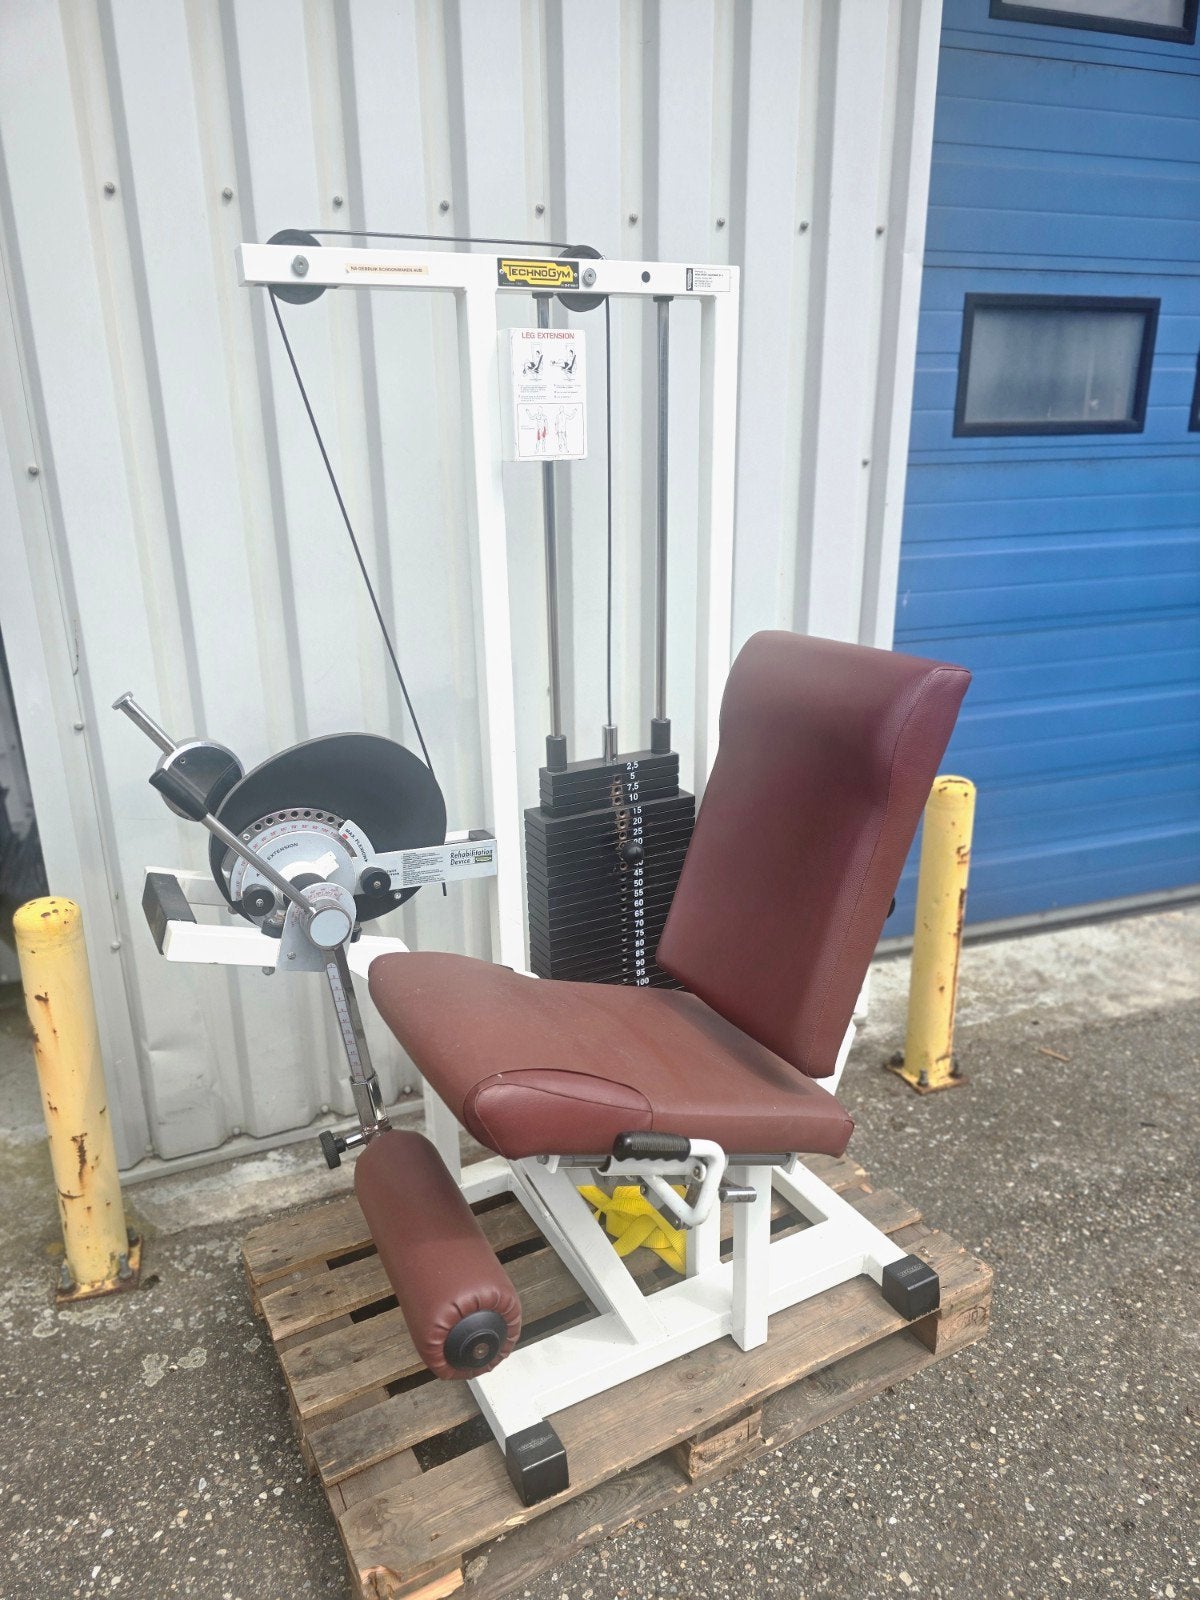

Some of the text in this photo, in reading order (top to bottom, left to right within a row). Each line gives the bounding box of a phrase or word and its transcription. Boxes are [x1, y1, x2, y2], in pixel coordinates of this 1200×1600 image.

[521, 332, 576, 340] LEG EXTENSION
[626, 761, 639, 770] 2,5
[630, 772, 636, 780] 5
[626, 782, 639, 791] 7,5
[629, 793, 639, 801] 10
[633, 806, 642, 815] 15
[633, 816, 643, 825] 20
[633, 827, 643, 836] 25
[266, 842, 299, 861] EXTENSION
[450, 849, 493, 858] Rehabilitation
[633, 868, 644, 877] 45
[633, 878, 644, 887] 50
[633, 888, 644, 897] 55
[633, 898, 644, 907] 60
[634, 908, 644, 917] 65
[634, 919, 645, 928] 70
[634, 929, 645, 938] 75
[635, 939, 645, 948] 80
[635, 949, 645, 958] 85
[635, 958, 645, 967] 90
[636, 968, 646, 977] 95
[636, 977, 650, 986] 100
